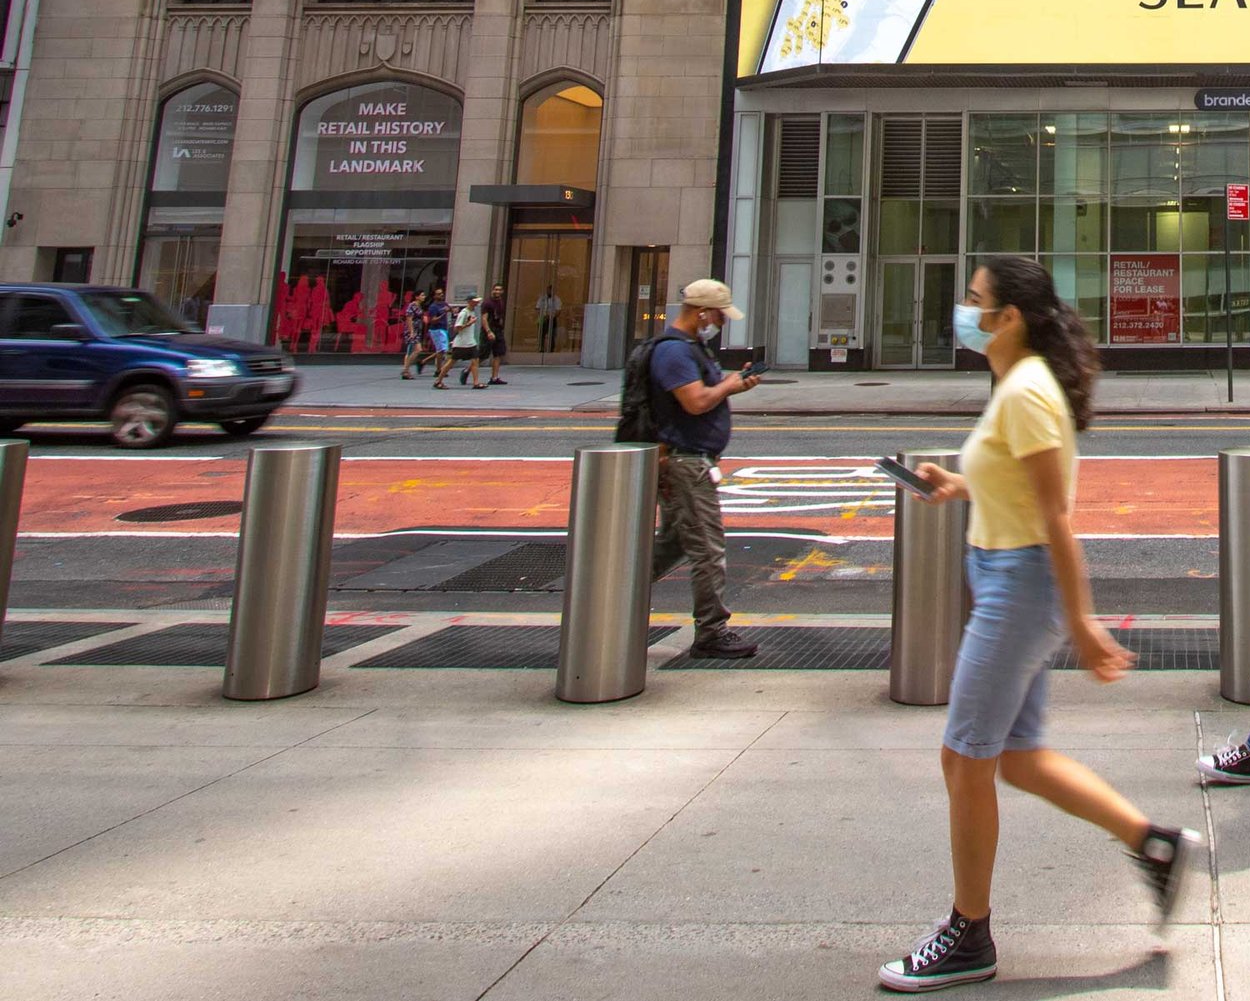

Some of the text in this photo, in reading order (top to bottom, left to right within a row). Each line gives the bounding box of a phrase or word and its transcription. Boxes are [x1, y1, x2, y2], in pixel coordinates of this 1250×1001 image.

[176, 104, 233, 113] 212.776.1291
[358, 103, 407, 115] MAKE
[317, 121, 445, 135] RETAIL HISTORY
[349, 141, 407, 154] IN THIS
[329, 160, 424, 173] LANDMARK
[1113, 261, 1150, 269] RETAIL/
[1113, 269, 1174, 277] RESTAURANT
